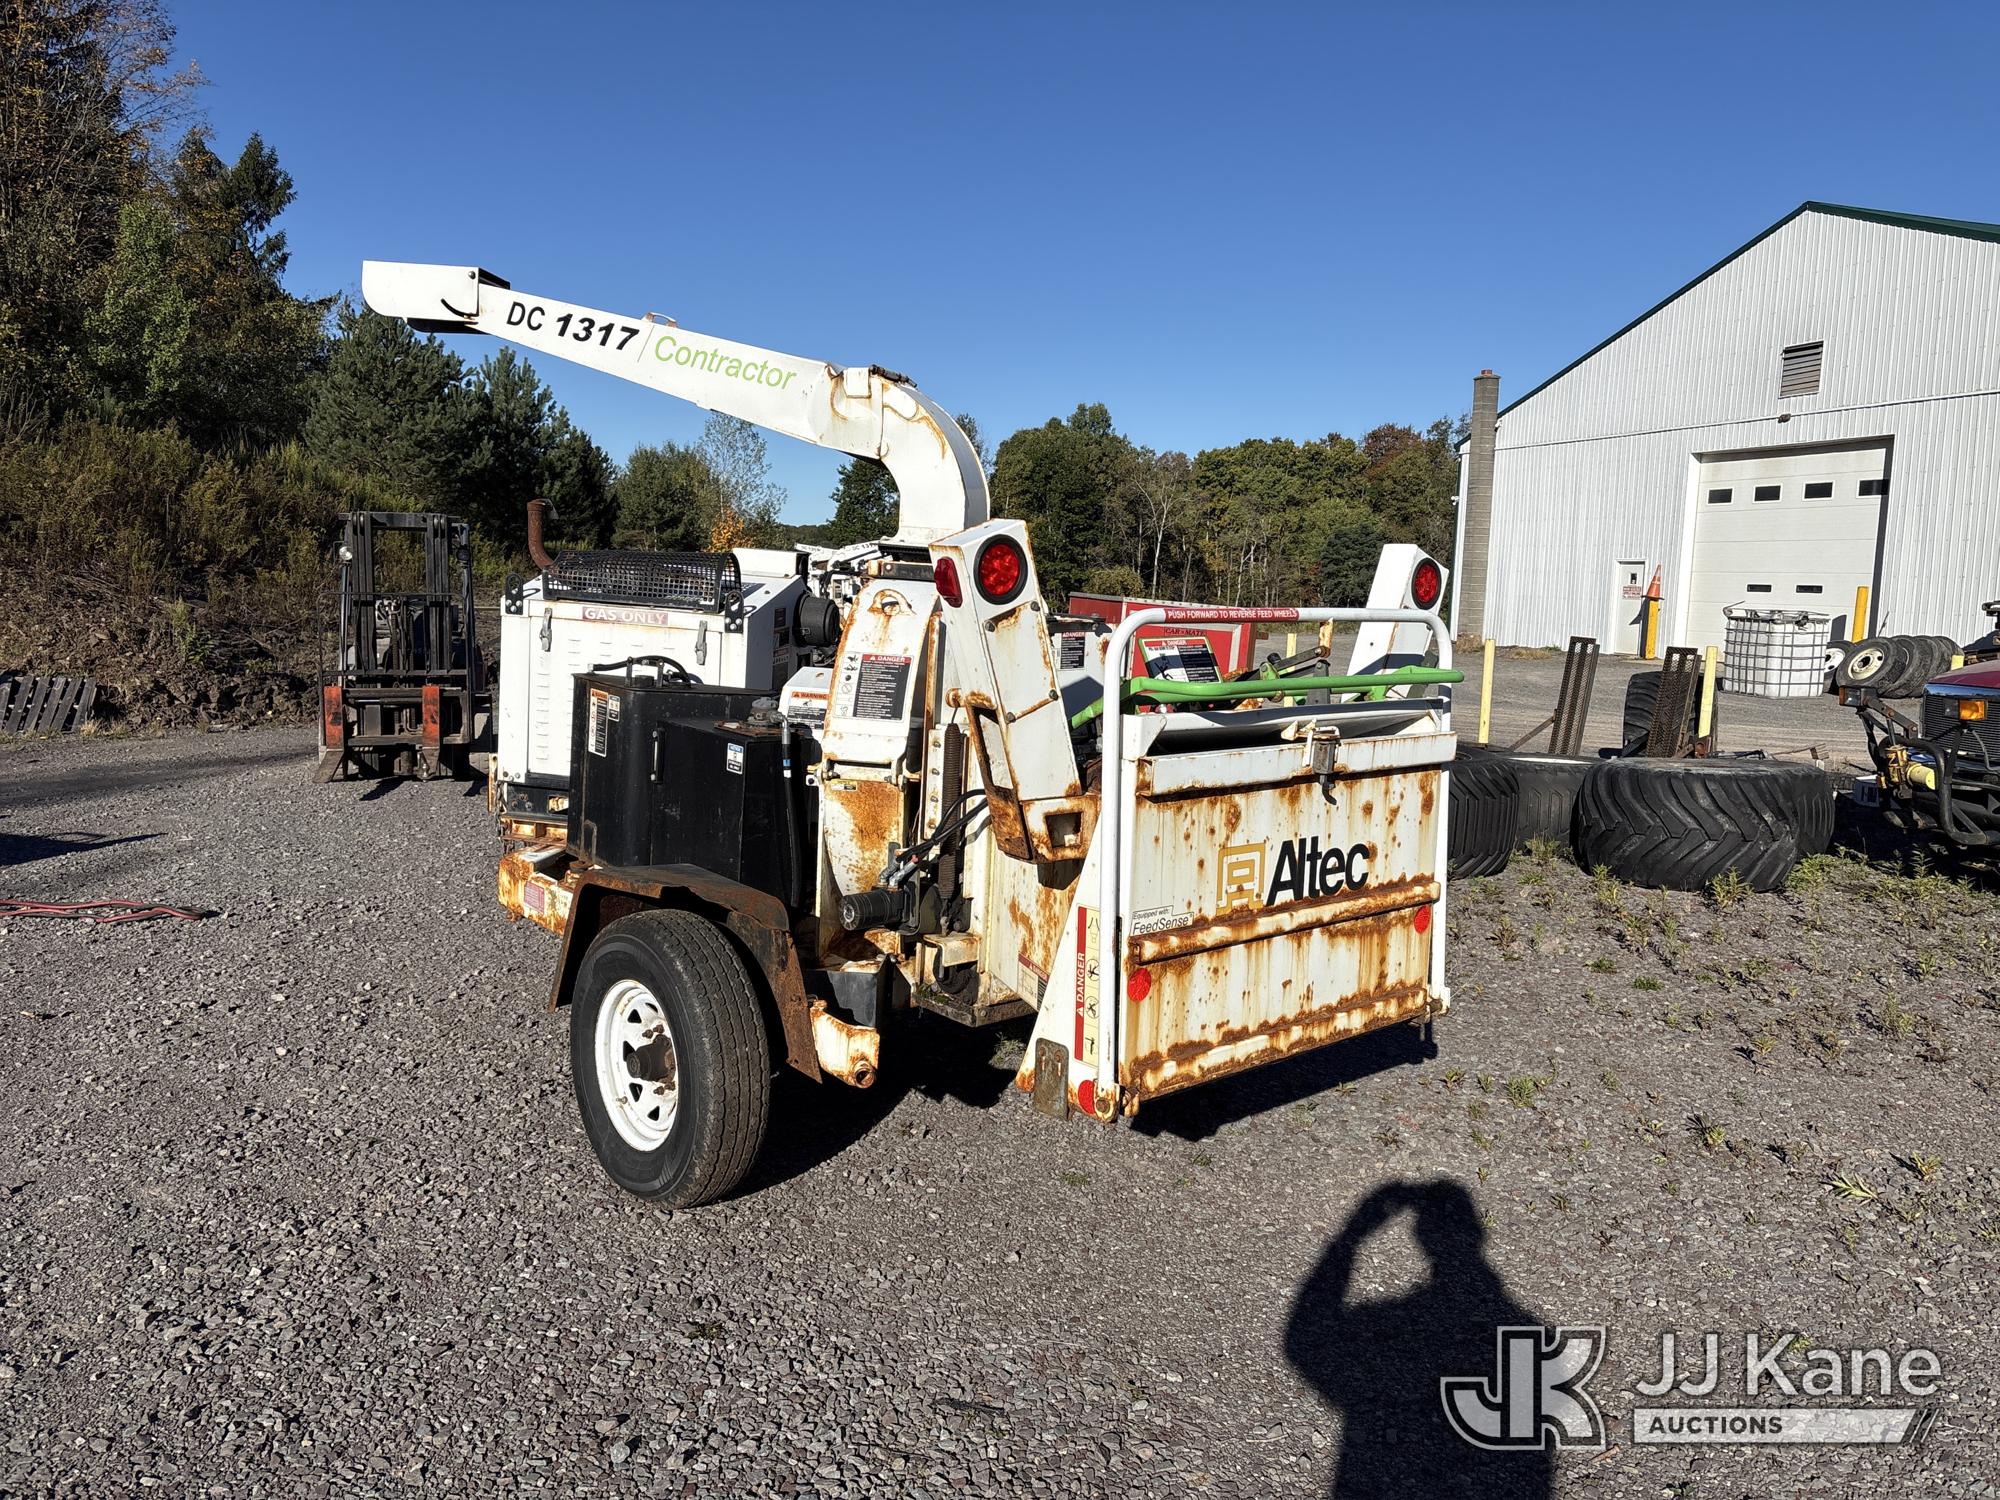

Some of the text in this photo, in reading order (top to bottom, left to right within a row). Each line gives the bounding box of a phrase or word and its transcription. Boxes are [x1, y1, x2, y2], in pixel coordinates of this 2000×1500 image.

[506, 301, 797, 389] DC 1317 Contractor
[585, 607, 665, 624] GAS ONLY
[1168, 609, 1298, 619] PUSH FORWARD TO REVERSE FEED WHEELS
[877, 655, 906, 663] DANGER
[1265, 836, 1370, 906] Altec
[1133, 909, 1158, 920] Equipped
[1076, 953, 1086, 1003] DANGER
